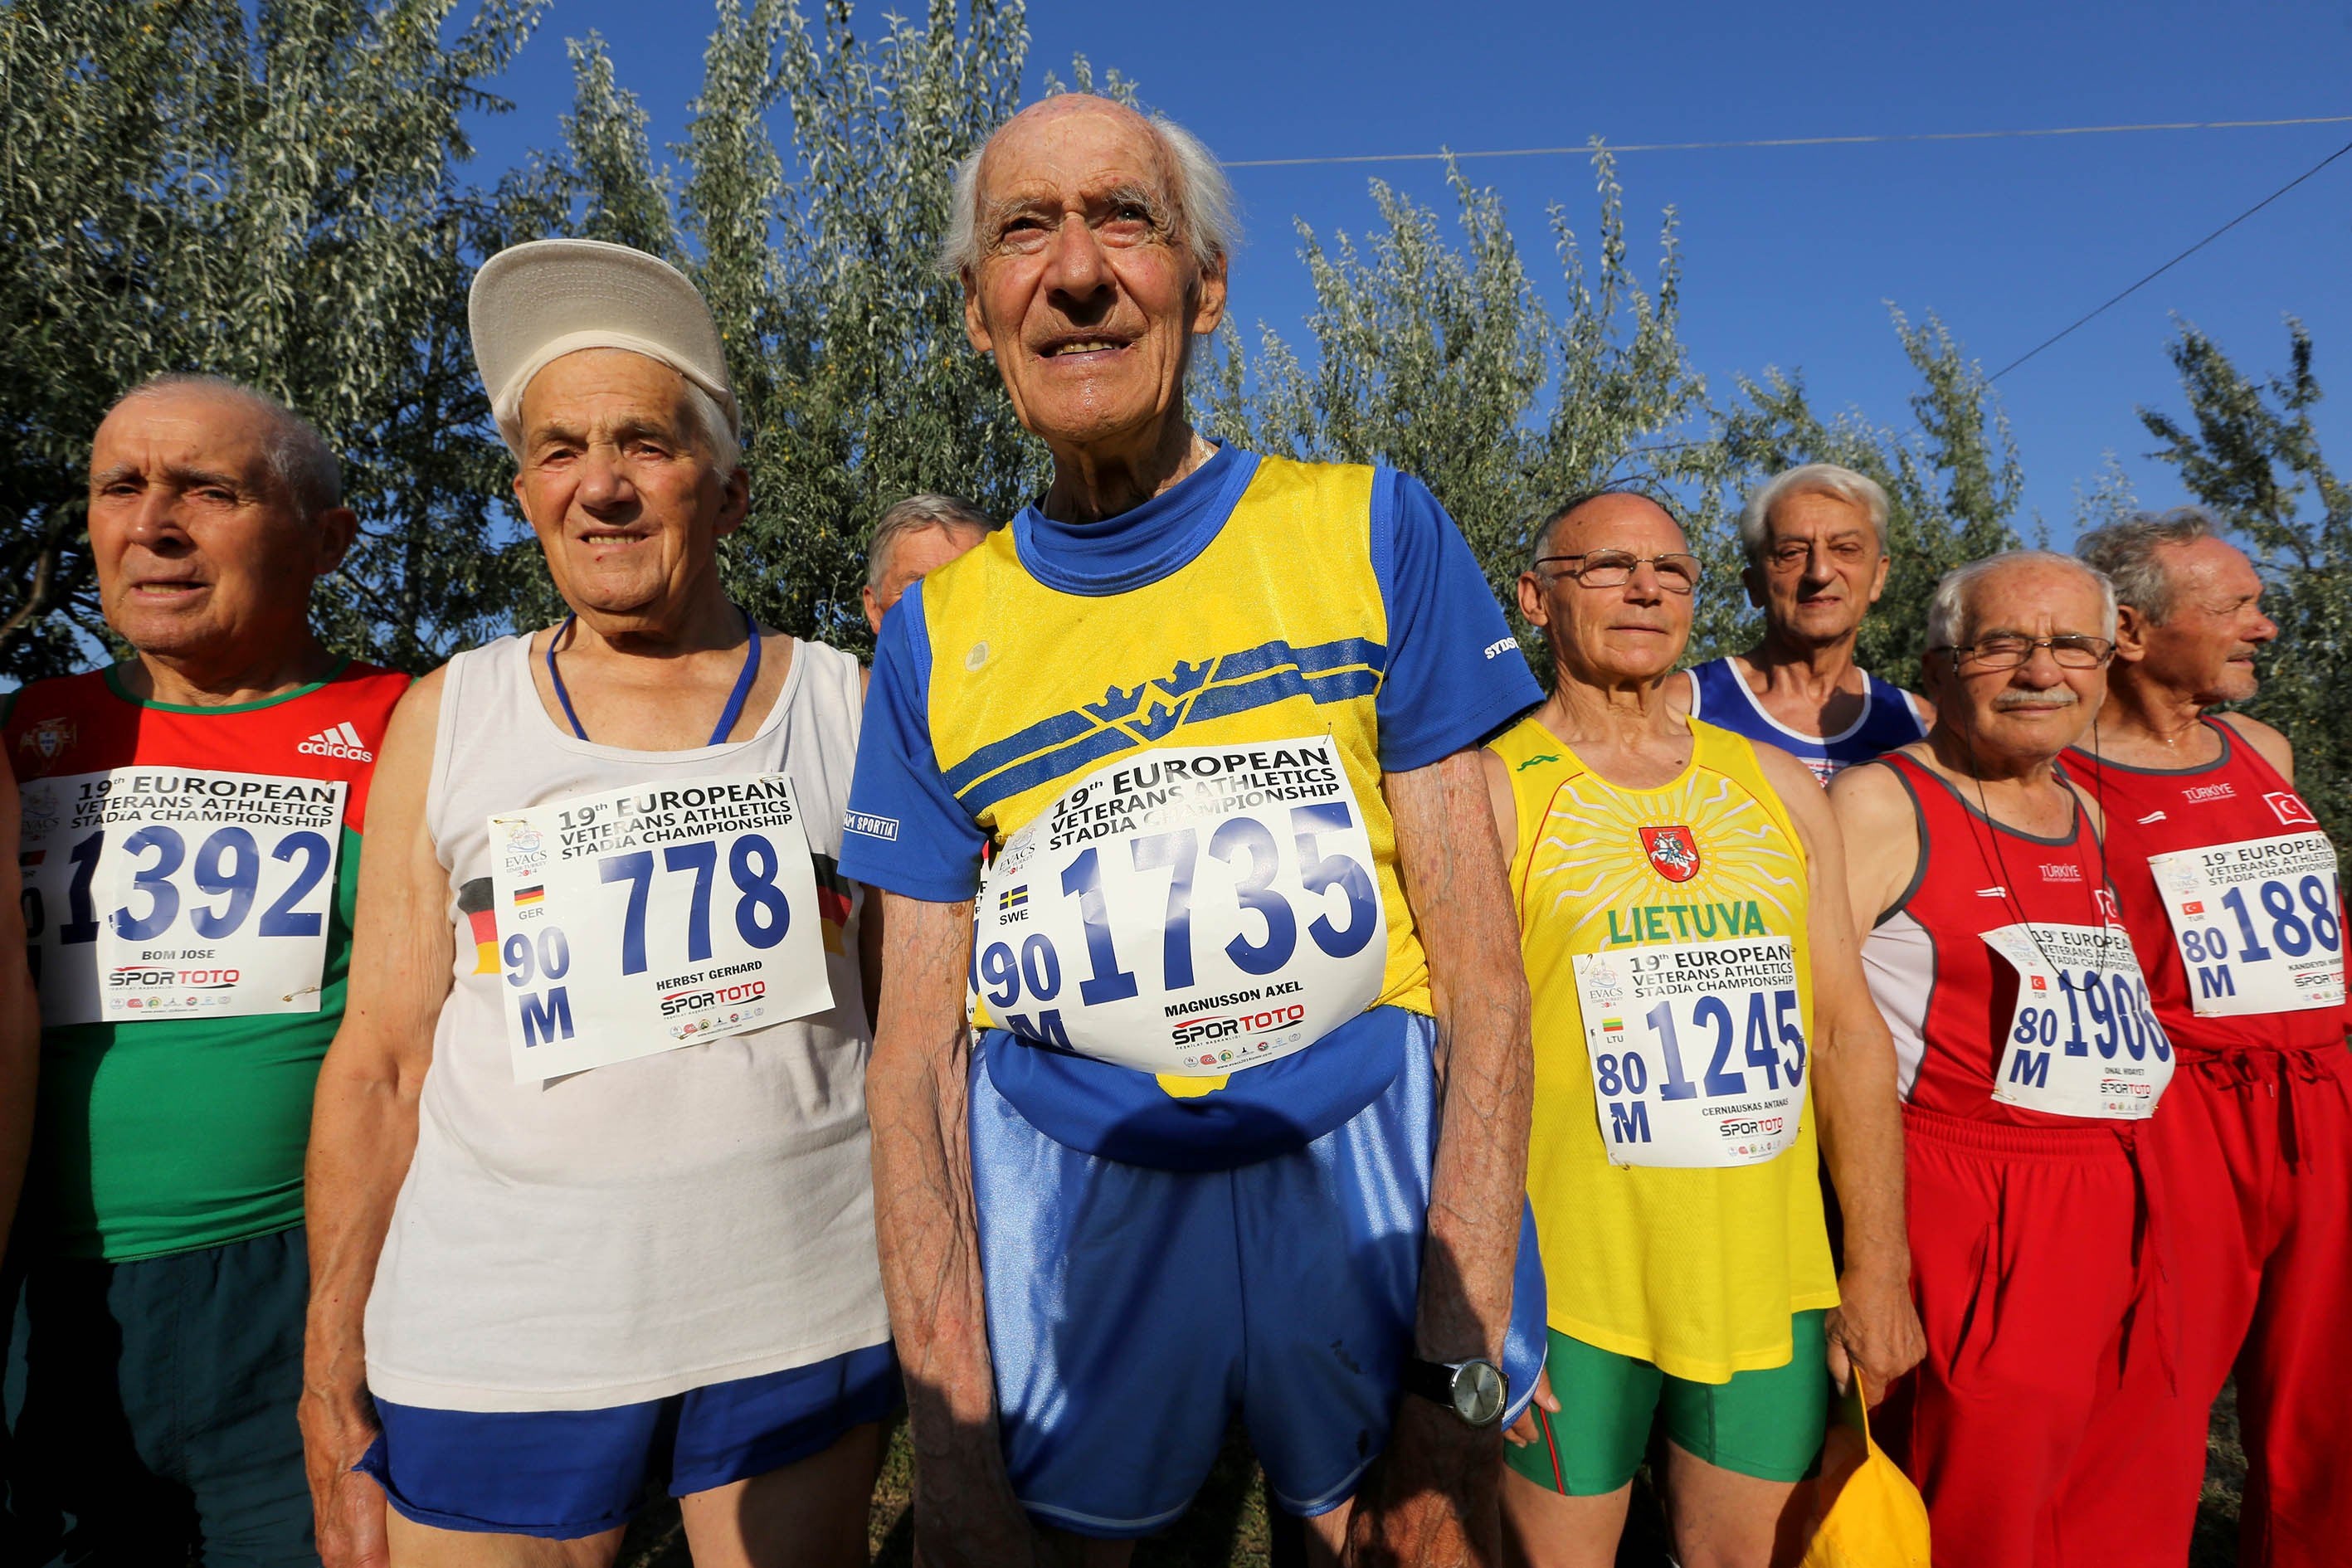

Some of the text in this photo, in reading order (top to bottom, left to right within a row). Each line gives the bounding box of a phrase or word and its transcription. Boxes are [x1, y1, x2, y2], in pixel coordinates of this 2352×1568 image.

[1484, 637, 1519, 660] SYDS
[297, 740, 373, 763] adidas
[1113, 747, 1330, 795] EUROPEAN
[133, 776, 336, 804] EUROPEAN
[616, 782, 786, 817] EUROPEAN
[1051, 767, 1337, 834] VETERANS ATHLETICS
[75, 796, 334, 817] VETERANS ATHLETICS
[150, 810, 332, 828] CHAMPIONSHIP
[560, 800, 791, 846] VETERANS ATHLETICS
[562, 814, 792, 860] STADIA CHAMPIONSHIP
[857, 816, 893, 837] SPORTIA
[1049, 816, 1137, 850] STADIA
[505, 850, 548, 868] EVACS
[999, 843, 1035, 871] EVACS
[2205, 859, 2277, 877] VETERANS
[60, 825, 332, 945] 1392
[2208, 872, 2256, 886] STADIA
[519, 907, 544, 920] GER
[597, 834, 790, 976] 778
[999, 908, 1029, 926] SWE
[1060, 801, 1378, 1006] 1735
[1608, 900, 1765, 944] LIETUVA
[142, 949, 216, 960] BOM JOSE
[2062, 931, 2131, 950] EUROPEA
[2182, 927, 2228, 963] 80
[503, 926, 570, 987] 90
[981, 933, 1061, 1008] 90
[1674, 945, 1791, 968] EUROPEAN
[2096, 949, 2137, 963] ATHLET
[656, 961, 762, 991] HERBST GERHARD
[1633, 962, 1793, 986] VETERANS ATHLETICS
[1635, 975, 1794, 998] STADIA CHAMPIONSHIP
[2197, 964, 2236, 1000] M
[1164, 981, 1303, 1017] MAGNUSSON AXEL
[1590, 987, 1624, 999] EVACS
[518, 986, 575, 1048] M
[2014, 1006, 2057, 1047] 80
[1606, 1035, 1624, 1044] LTU
[1646, 990, 1804, 1101] 1245
[1597, 1051, 1647, 1096] 80
[2009, 1049, 2050, 1088] M
[1610, 1101, 1652, 1143] M
[1702, 1098, 1789, 1116] CERNIAUSKAS ANTANAS
